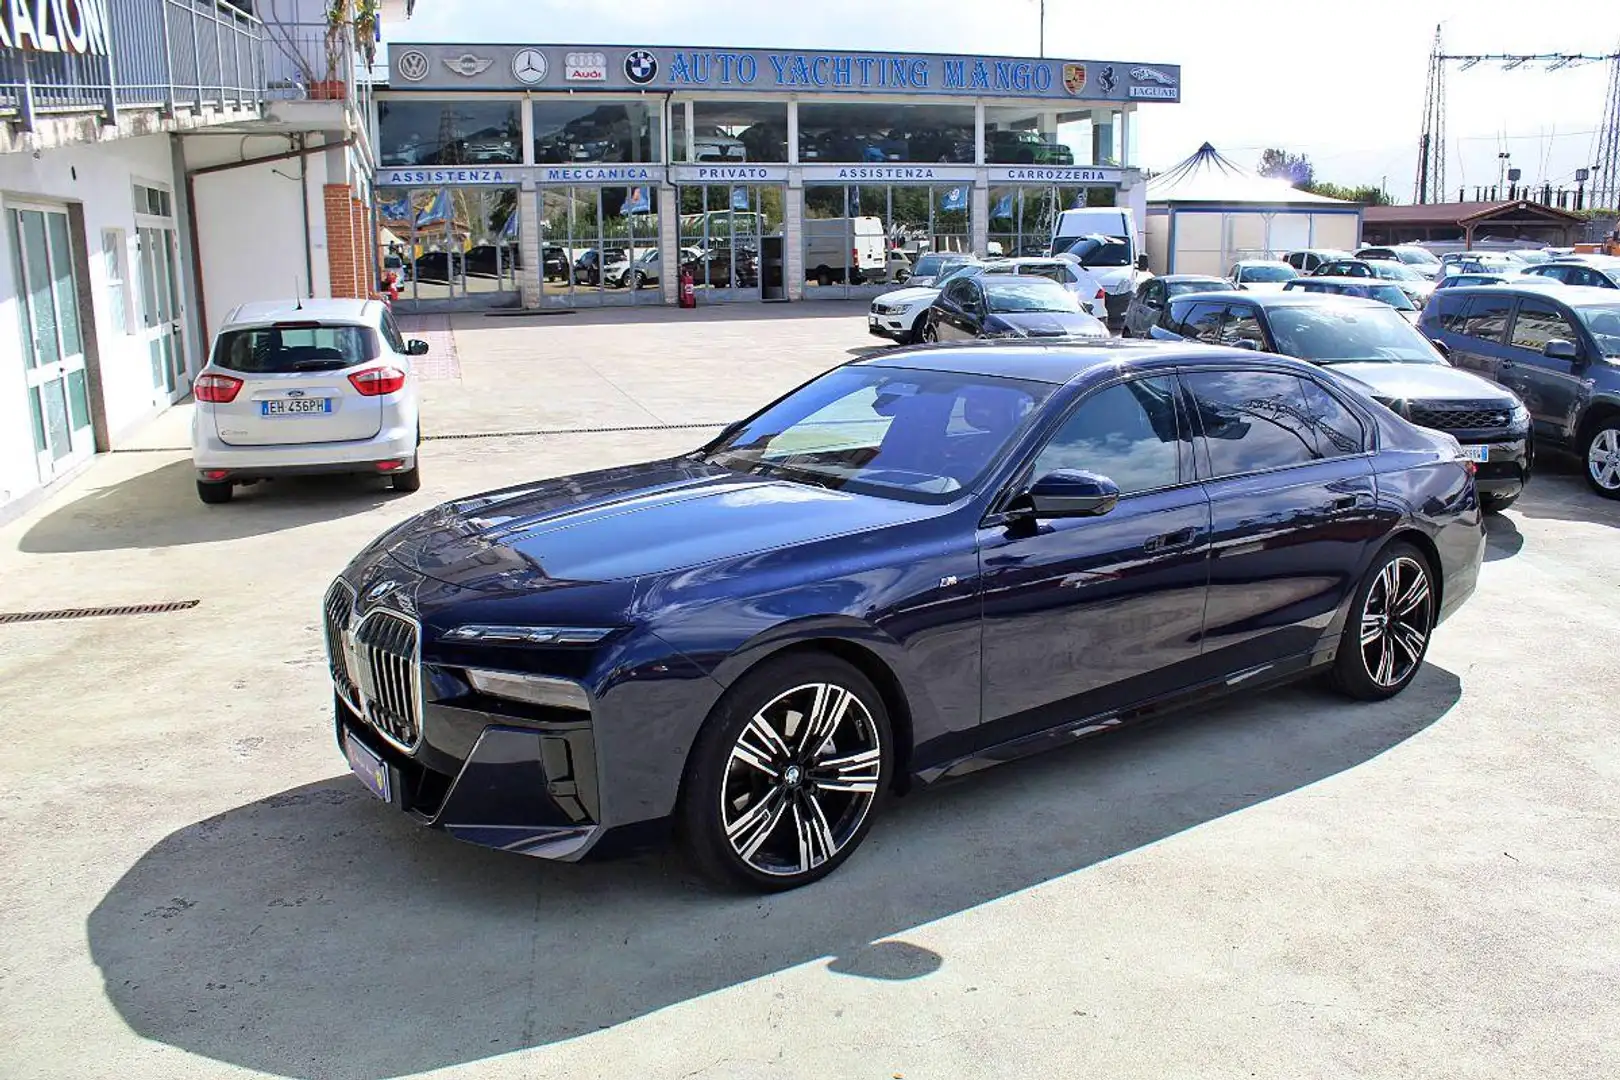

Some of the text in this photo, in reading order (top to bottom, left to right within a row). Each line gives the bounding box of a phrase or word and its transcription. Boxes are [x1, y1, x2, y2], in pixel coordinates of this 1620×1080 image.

[572, 70, 602, 78] Audi
[669, 51, 1052, 92] AUTO YACHTING MANGO
[1133, 86, 1176, 97] JAGUAR
[391, 171, 503, 183] ASSISTENZA
[548, 168, 649, 180] MECCANICA
[699, 168, 768, 179] PRIVATO
[839, 168, 935, 179] ASSISTENZA
[1007, 169, 1106, 181] CARROZZERIA
[270, 401, 285, 413] EH
